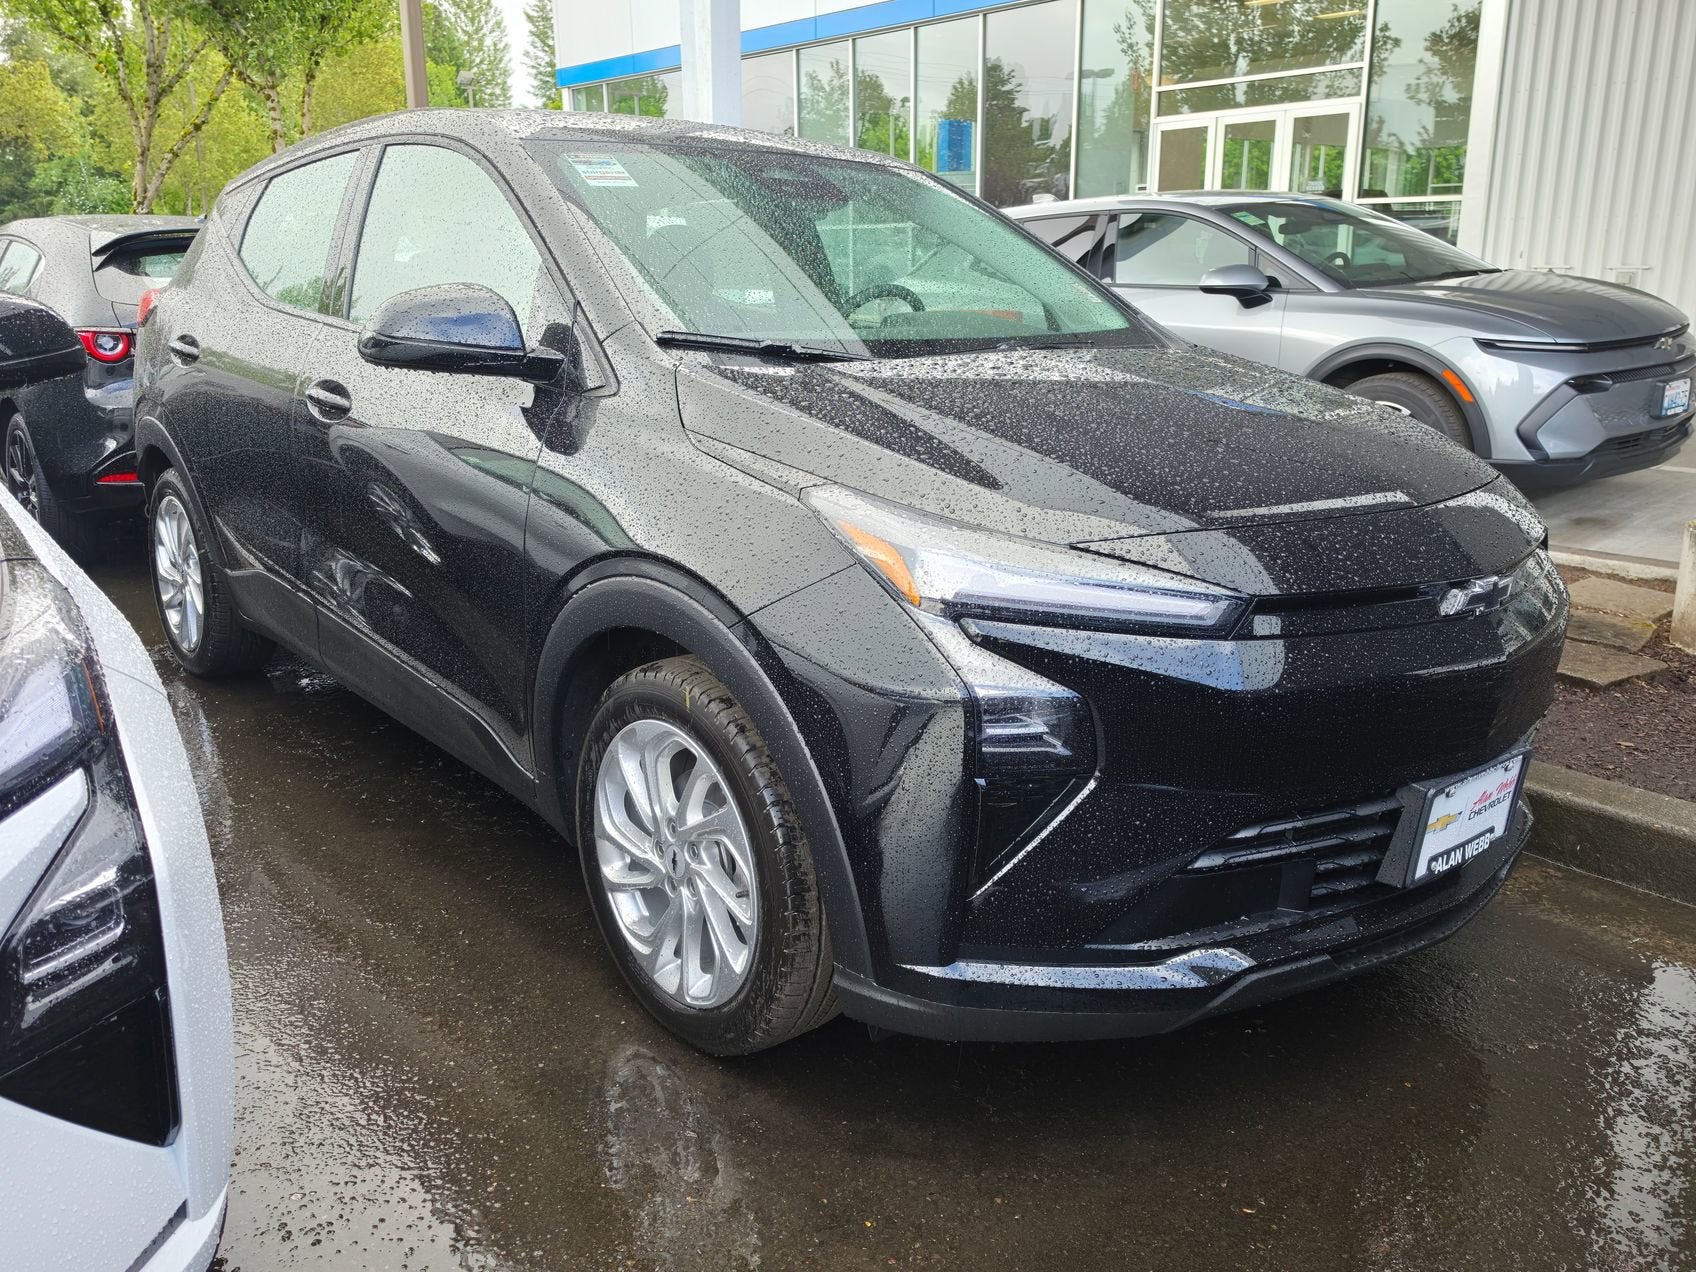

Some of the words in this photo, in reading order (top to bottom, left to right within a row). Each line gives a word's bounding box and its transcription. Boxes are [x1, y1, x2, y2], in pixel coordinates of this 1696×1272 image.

[1468, 790, 1512, 820] CHEVROLET
[1435, 847, 1463, 874] ALAN
[1465, 834, 1490, 860] WEBB
